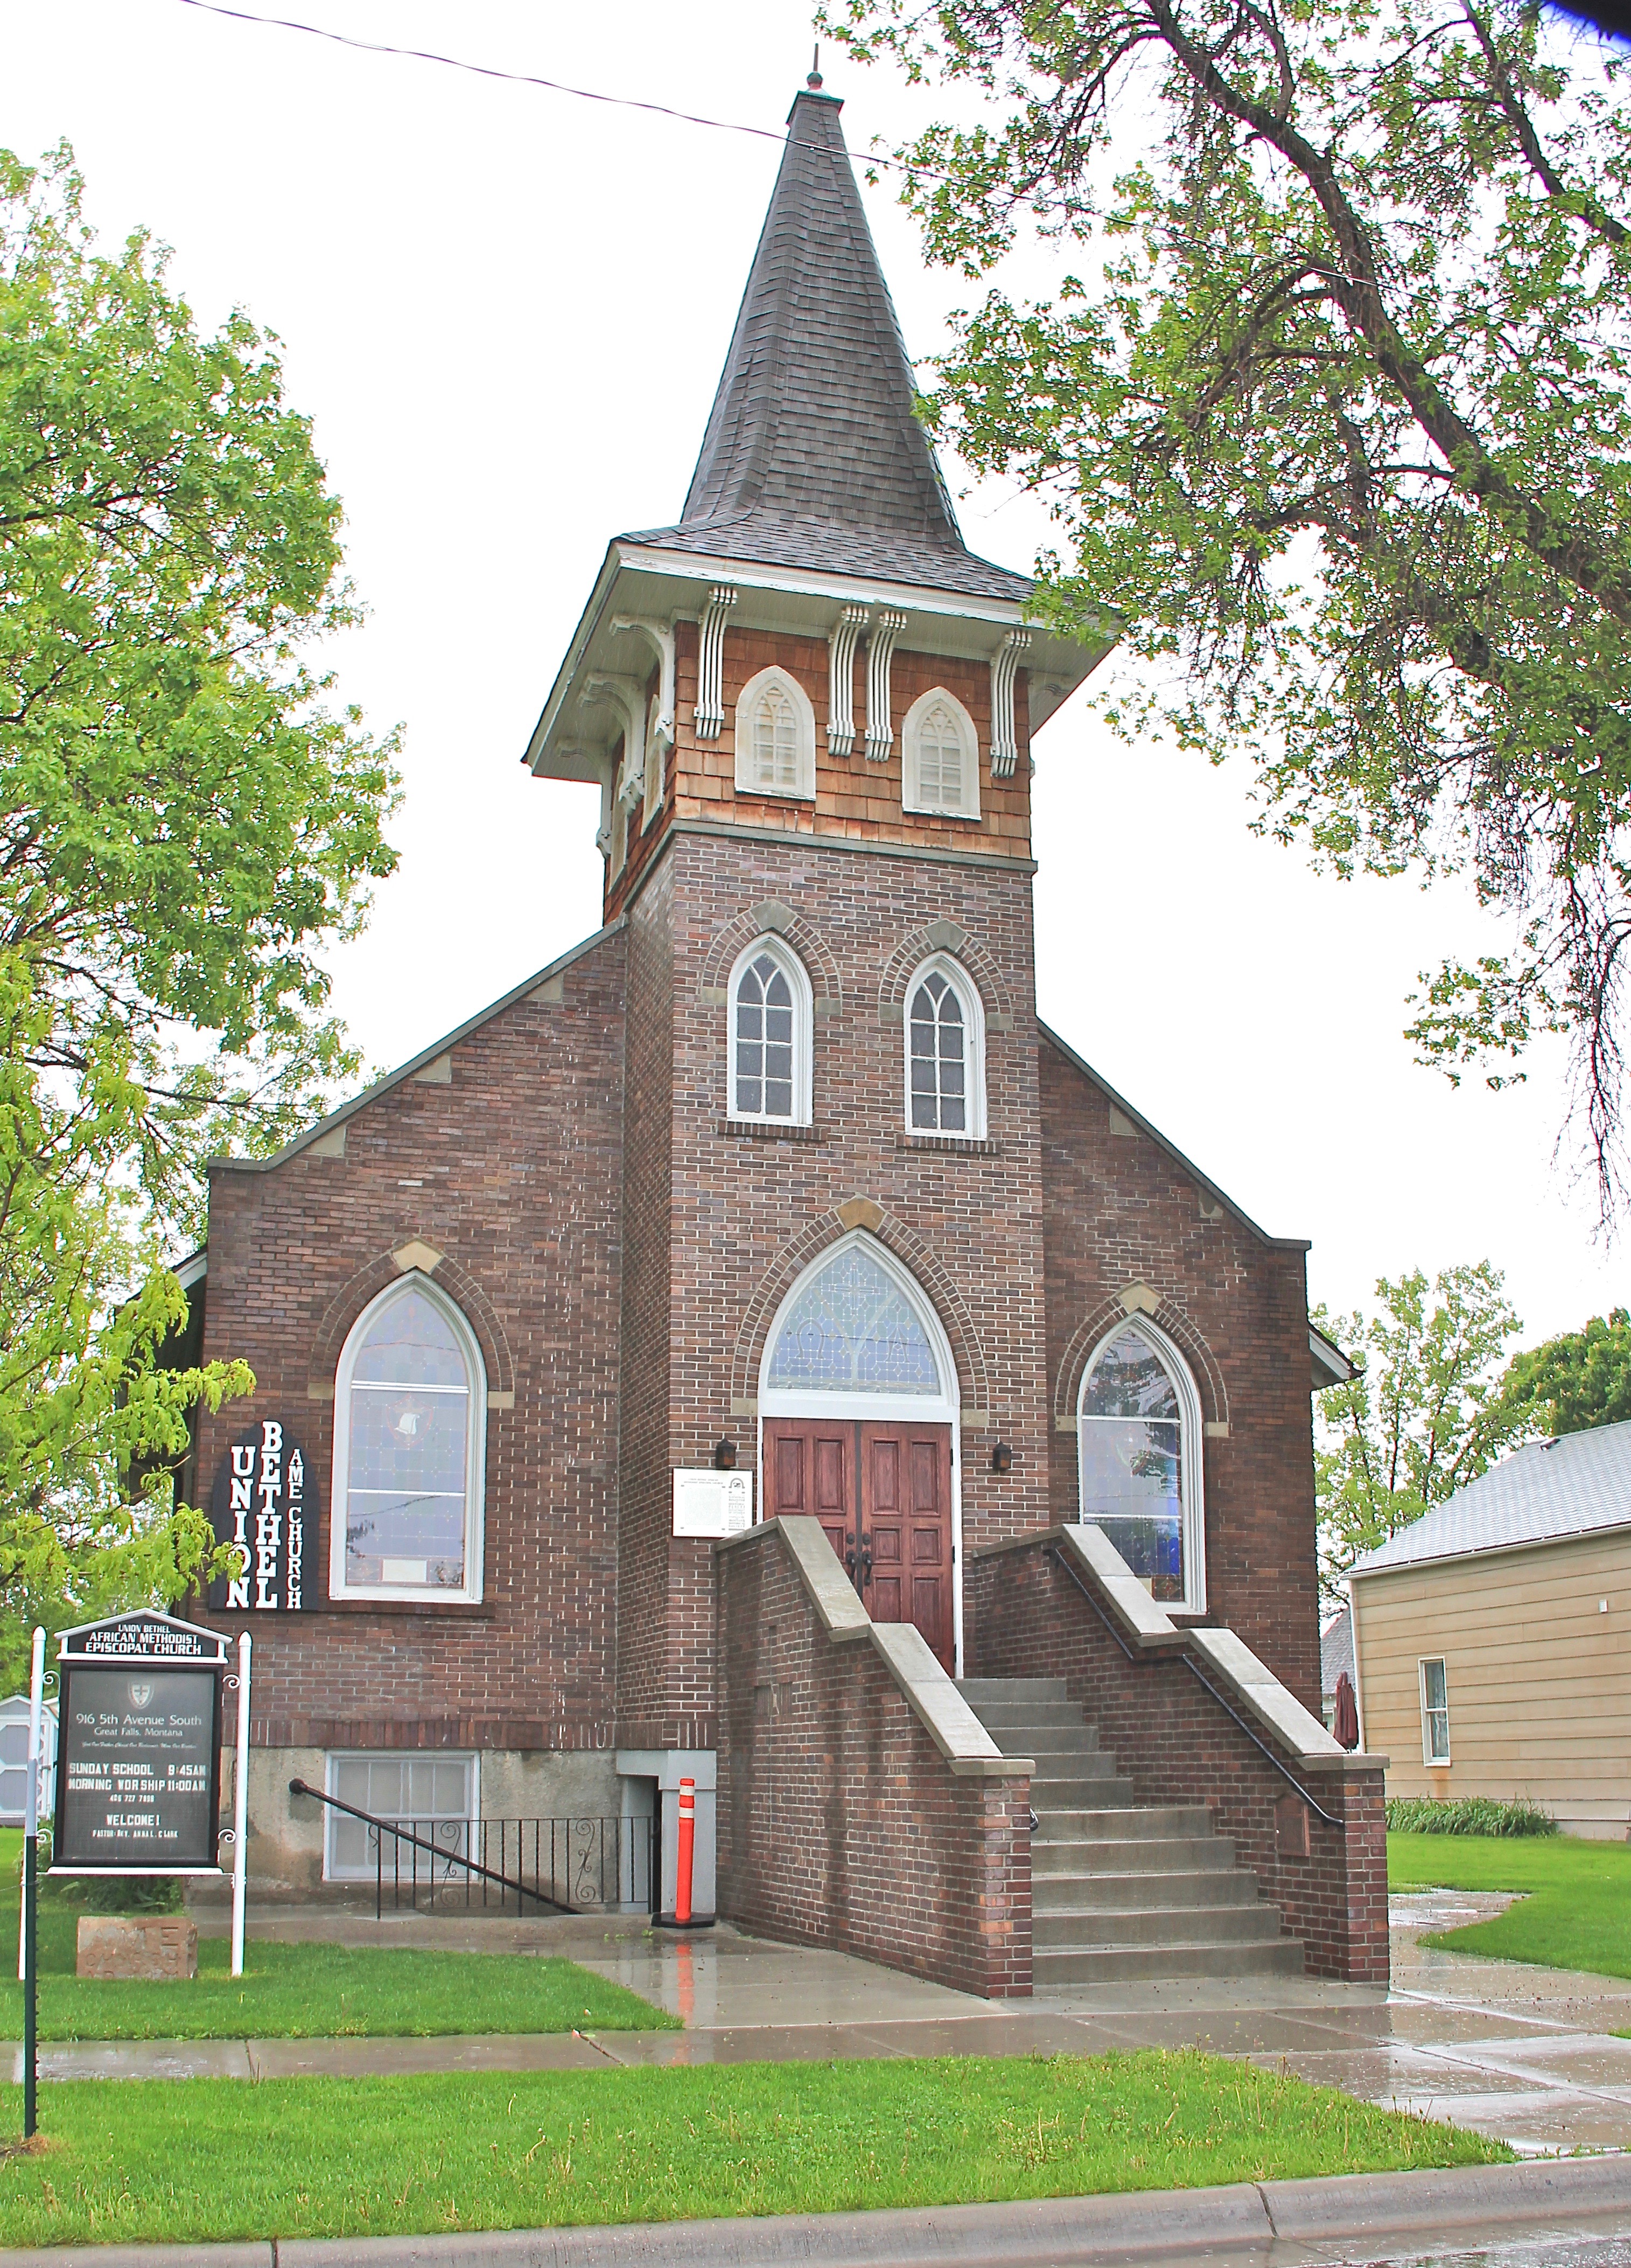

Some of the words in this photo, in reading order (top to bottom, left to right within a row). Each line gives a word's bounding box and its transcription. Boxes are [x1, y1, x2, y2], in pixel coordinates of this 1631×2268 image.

[288, 1448, 304, 1499] AME
[255, 1421, 283, 1608] BETHEL
[287, 1506, 304, 1609] CHURCH
[118, 1624, 141, 1632] UNION
[143, 1625, 170, 1633] BETHEL
[88, 1632, 136, 1643] AFRICAN
[139, 1633, 198, 1644] METHODIST
[85, 1642, 149, 1653] EPISCOPAL
[153, 1643, 201, 1655] CHURCH
[76, 1713, 95, 1725] 916
[100, 1714, 118, 1725] 5th
[123, 1714, 164, 1725] Avenue
[170, 1715, 201, 1726] South
[94, 1727, 117, 1736] Great
[145, 1728, 183, 1736] Montana
[68, 1762, 109, 1775] SUNDAY
[112, 1763, 154, 1775] SCHOOL
[68, 1778, 112, 1790] MORNING
[106, 1813, 160, 1826] WELCOME!
